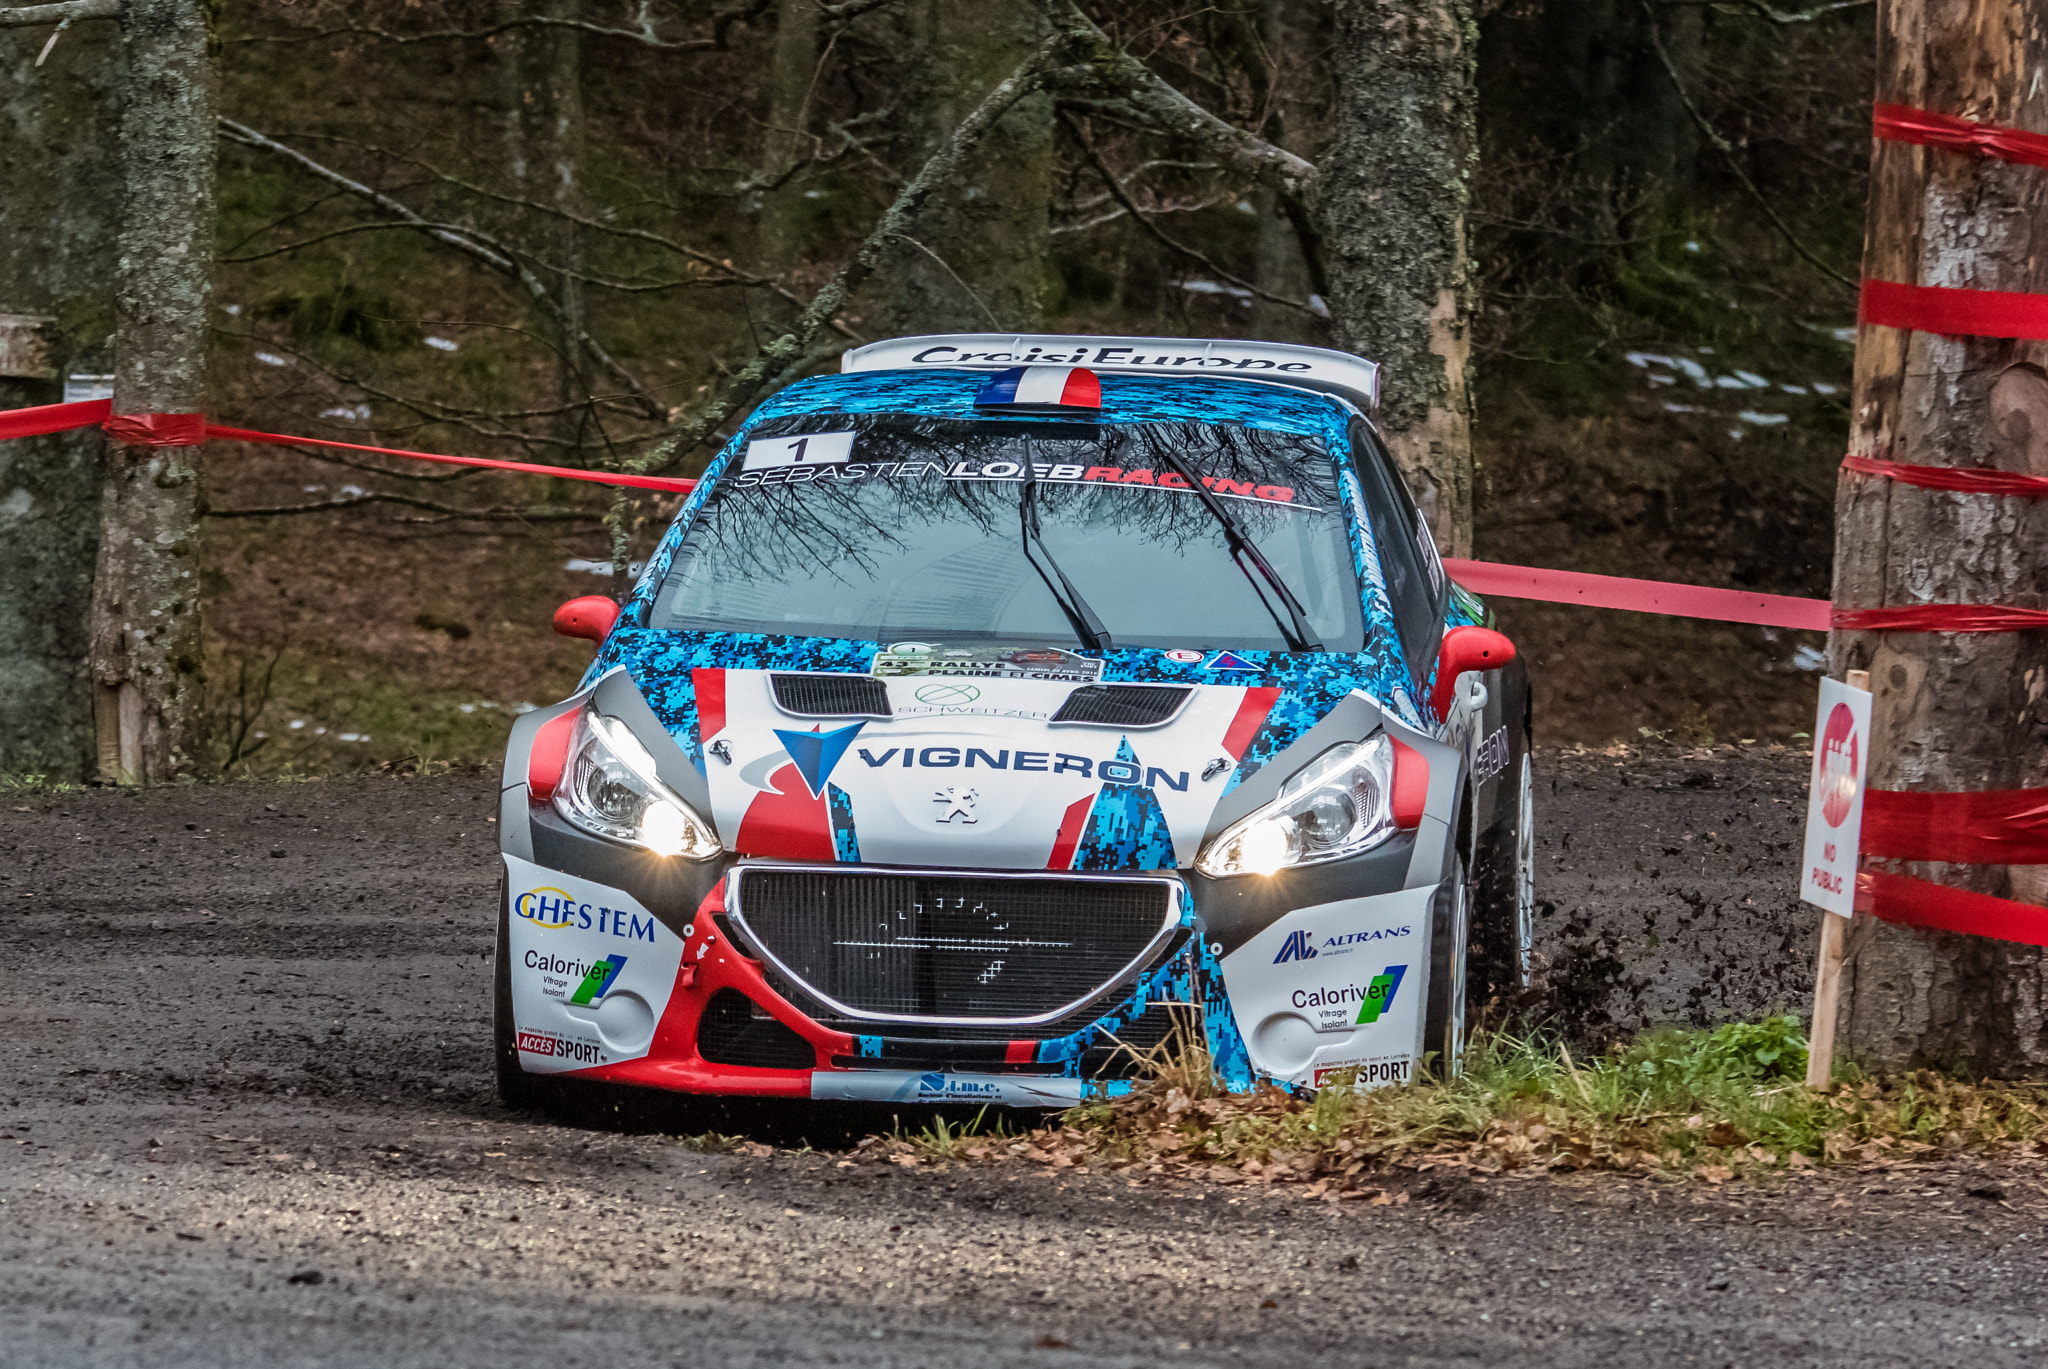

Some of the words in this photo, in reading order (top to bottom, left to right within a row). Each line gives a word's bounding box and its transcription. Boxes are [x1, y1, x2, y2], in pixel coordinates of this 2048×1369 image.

[912, 346, 1312, 373] CroisiEurope
[787, 437, 809, 462] 1
[928, 669, 1002, 677] PLAINE
[1031, 673, 1095, 682] CIMES
[929, 661, 1006, 669] RALLYE
[898, 706, 1047, 718] SCHWEITZER
[857, 747, 1190, 793] VIGNERON
[1823, 842, 1836, 863] NO
[1812, 866, 1843, 895] PUBLIC
[514, 892, 655, 943] GHESTEM
[1323, 925, 1411, 948] ALTRANS
[524, 949, 611, 982] Caloriver
[542, 986, 566, 998] Isolant
[543, 975, 568, 988] Vitrage
[1291, 983, 1390, 1009] Caloriver
[1318, 1008, 1348, 1020] Vitrage
[1321, 1019, 1348, 1030] Isolant
[556, 1039, 600, 1064] SPORT
[1358, 1060, 1409, 1083] SPORT
